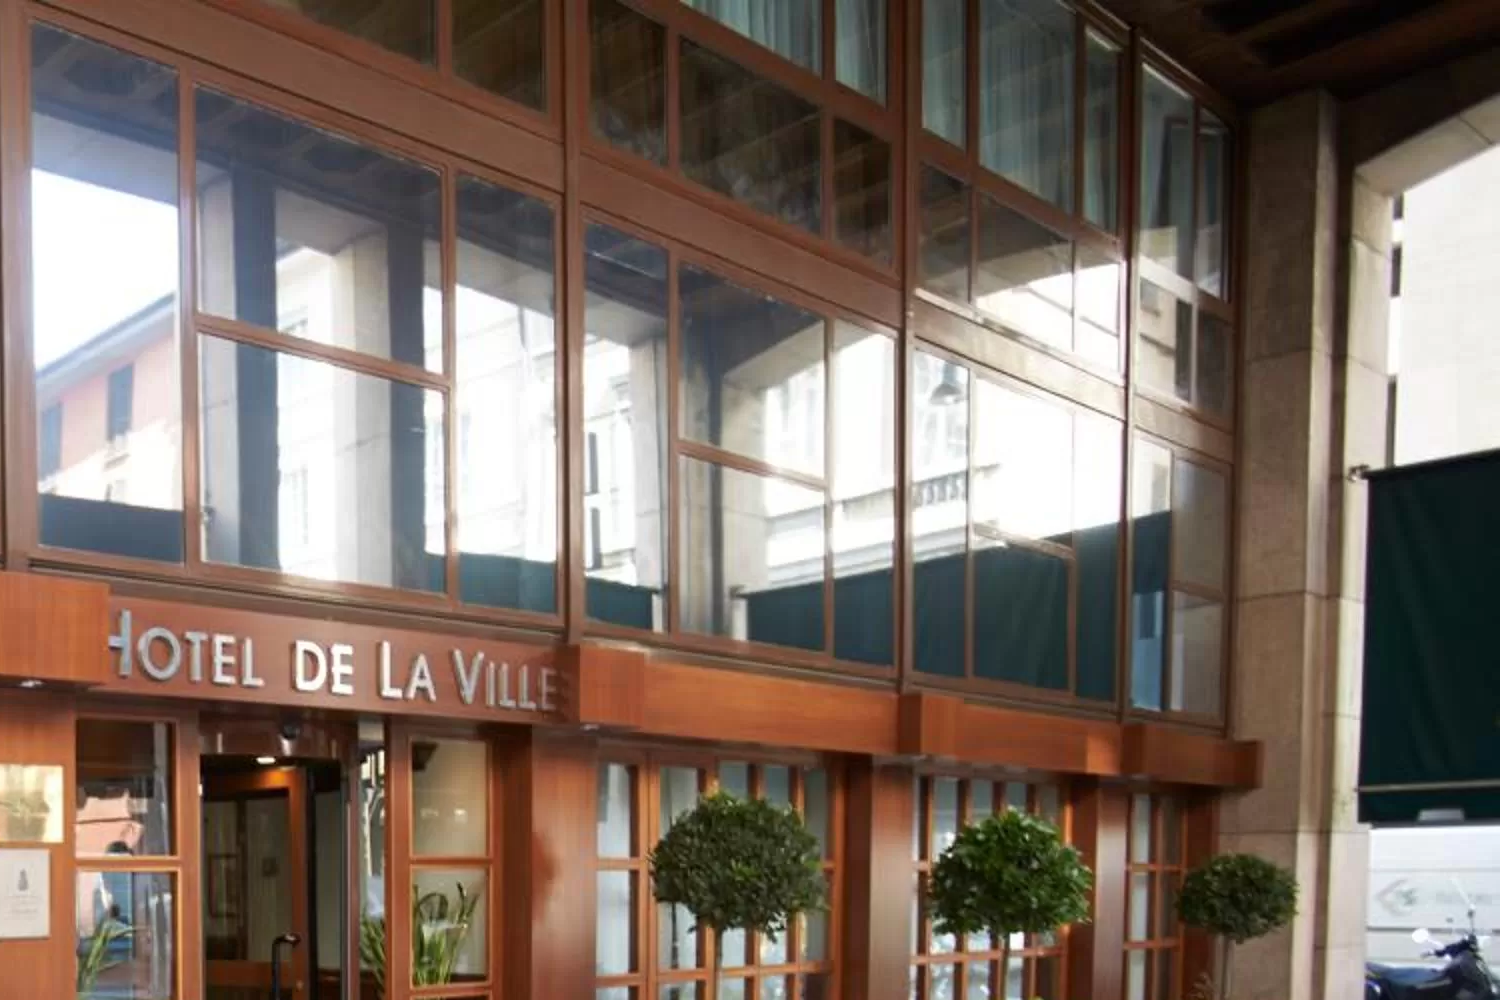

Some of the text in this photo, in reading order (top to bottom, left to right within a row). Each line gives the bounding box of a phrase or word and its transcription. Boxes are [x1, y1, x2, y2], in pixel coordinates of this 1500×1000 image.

[107, 608, 558, 711] HOTEL DE LA VILLE
